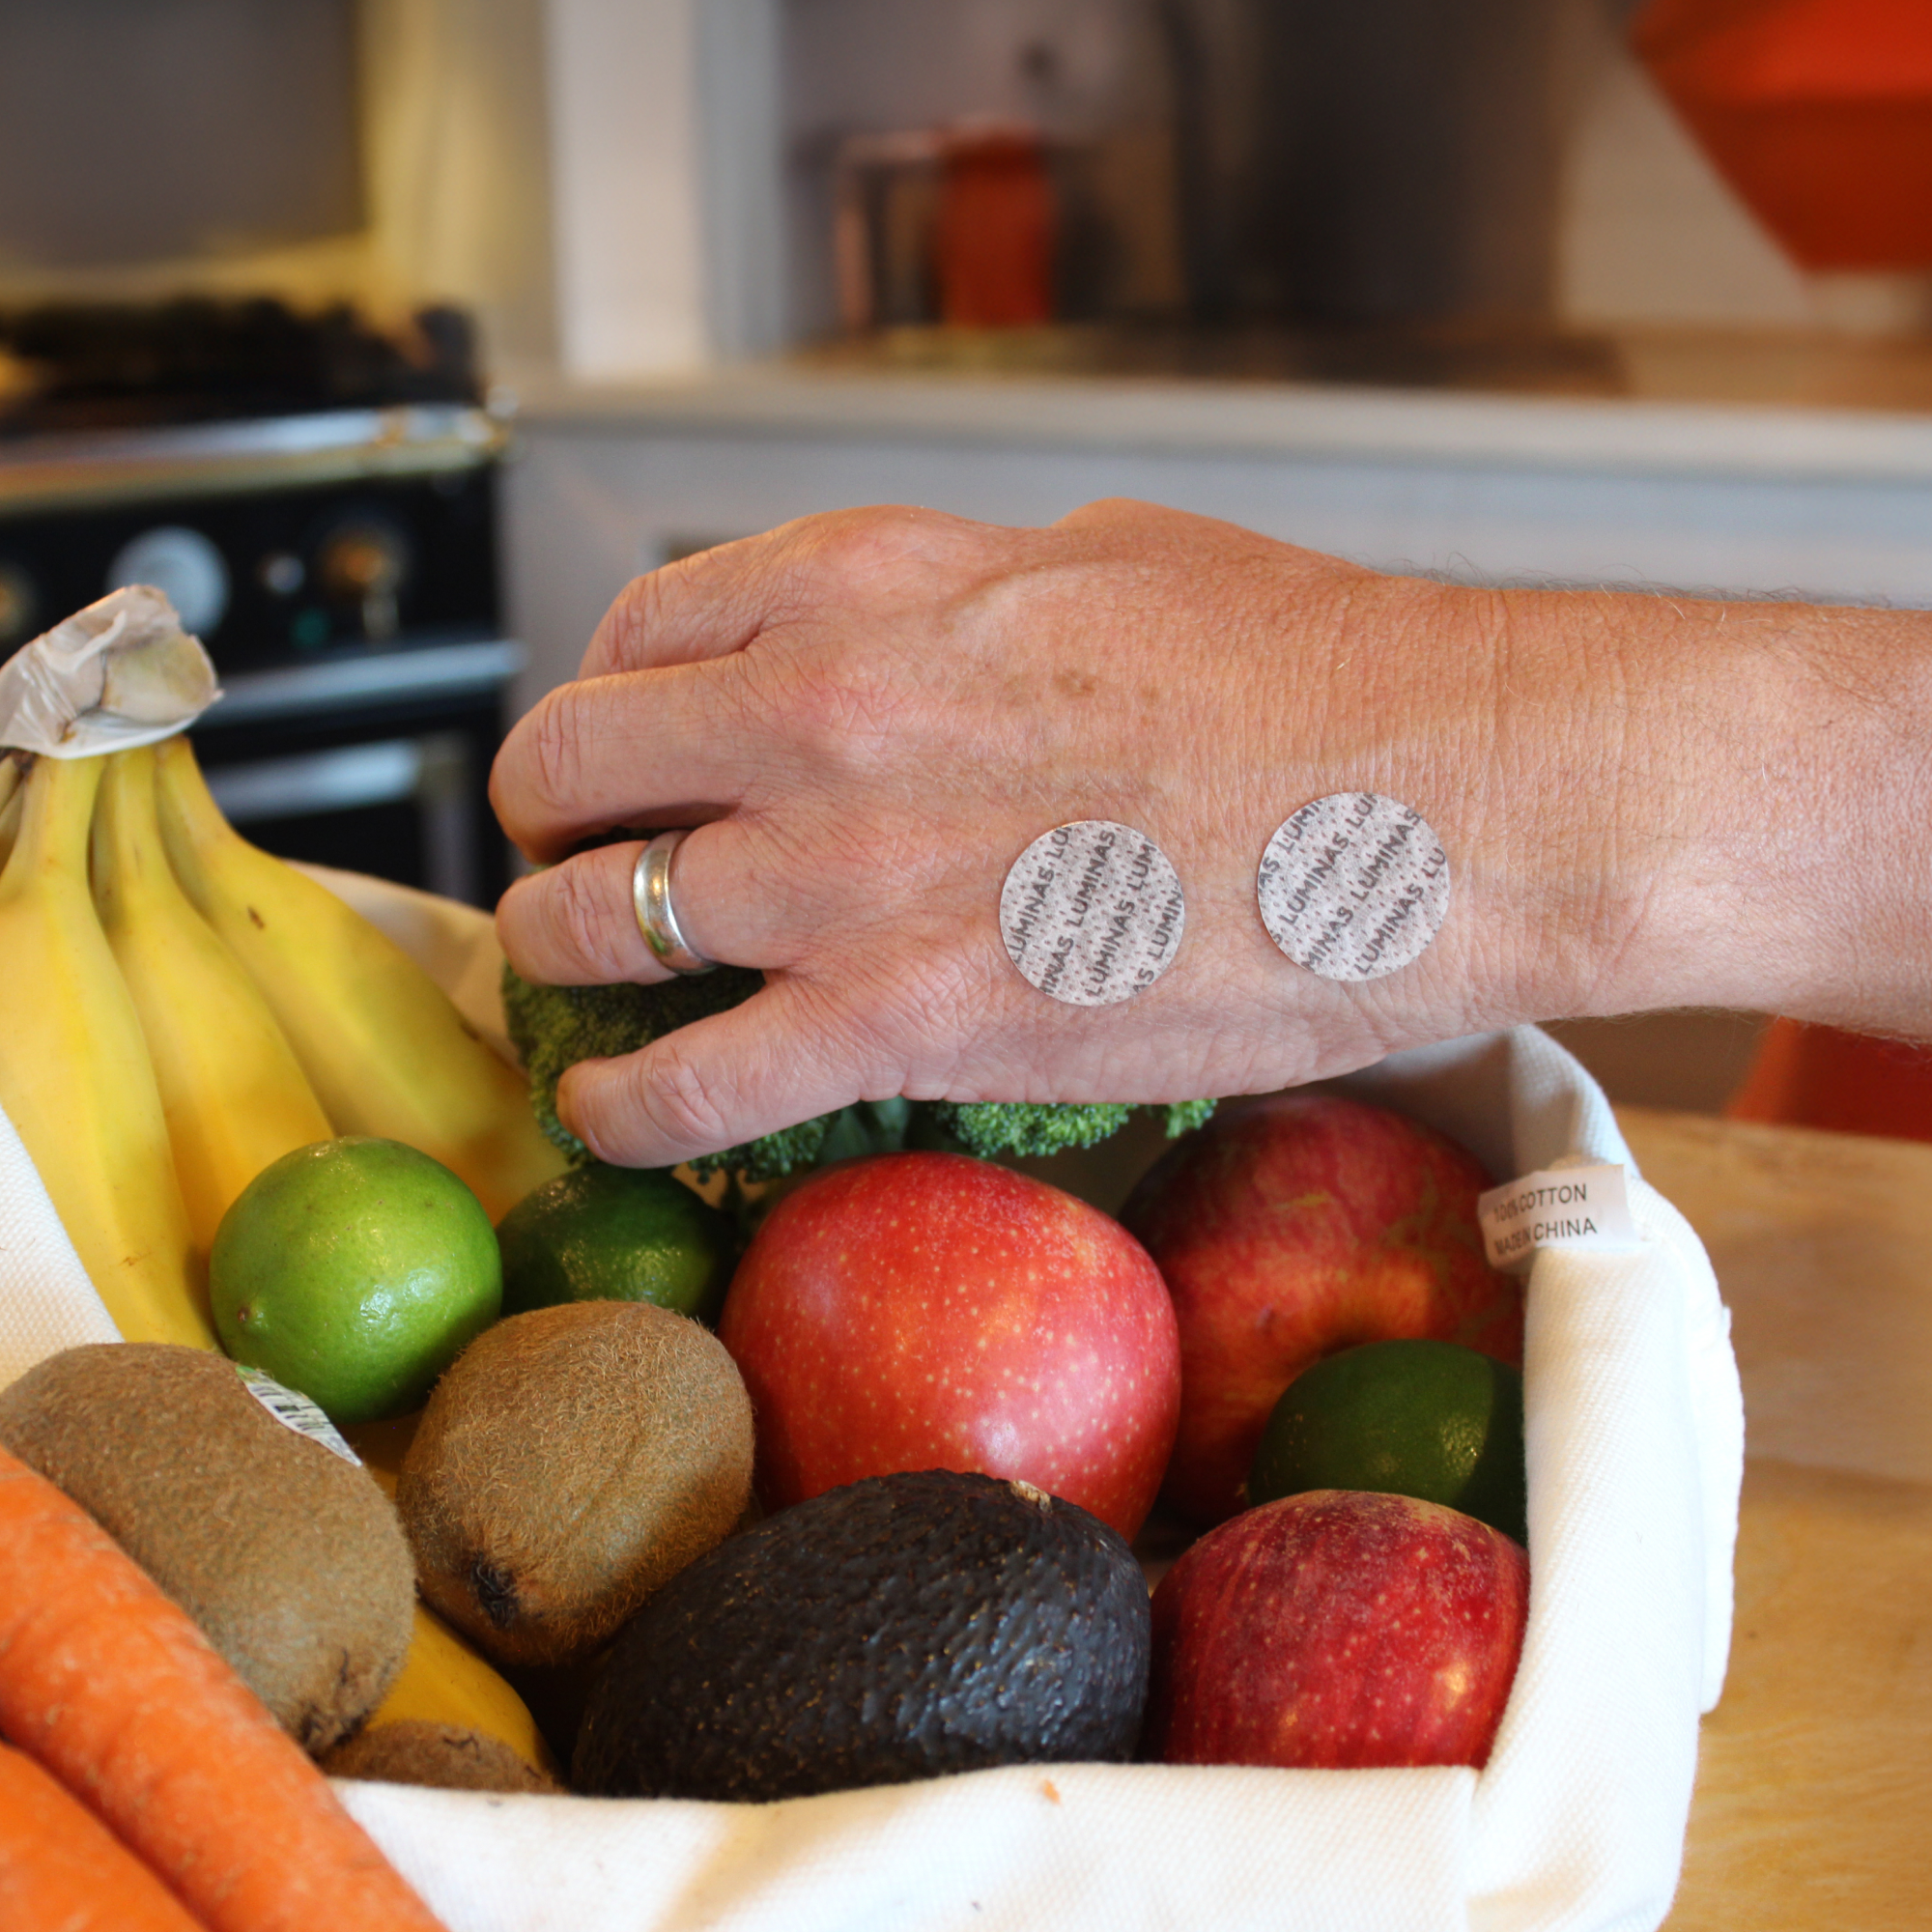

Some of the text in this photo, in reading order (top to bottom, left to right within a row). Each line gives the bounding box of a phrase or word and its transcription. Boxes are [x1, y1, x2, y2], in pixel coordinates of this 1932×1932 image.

[1065, 830, 1116, 927] LUMINAS
[1278, 832, 1350, 925] LUMINAS
[1350, 808, 1422, 902] LUMINAS
[1085, 899, 1136, 996] LUMINAS
[1353, 883, 1425, 975] LUMINAS
[1520, 1182, 1587, 1212] COTTON
[1534, 1217, 1598, 1241] CHINA
